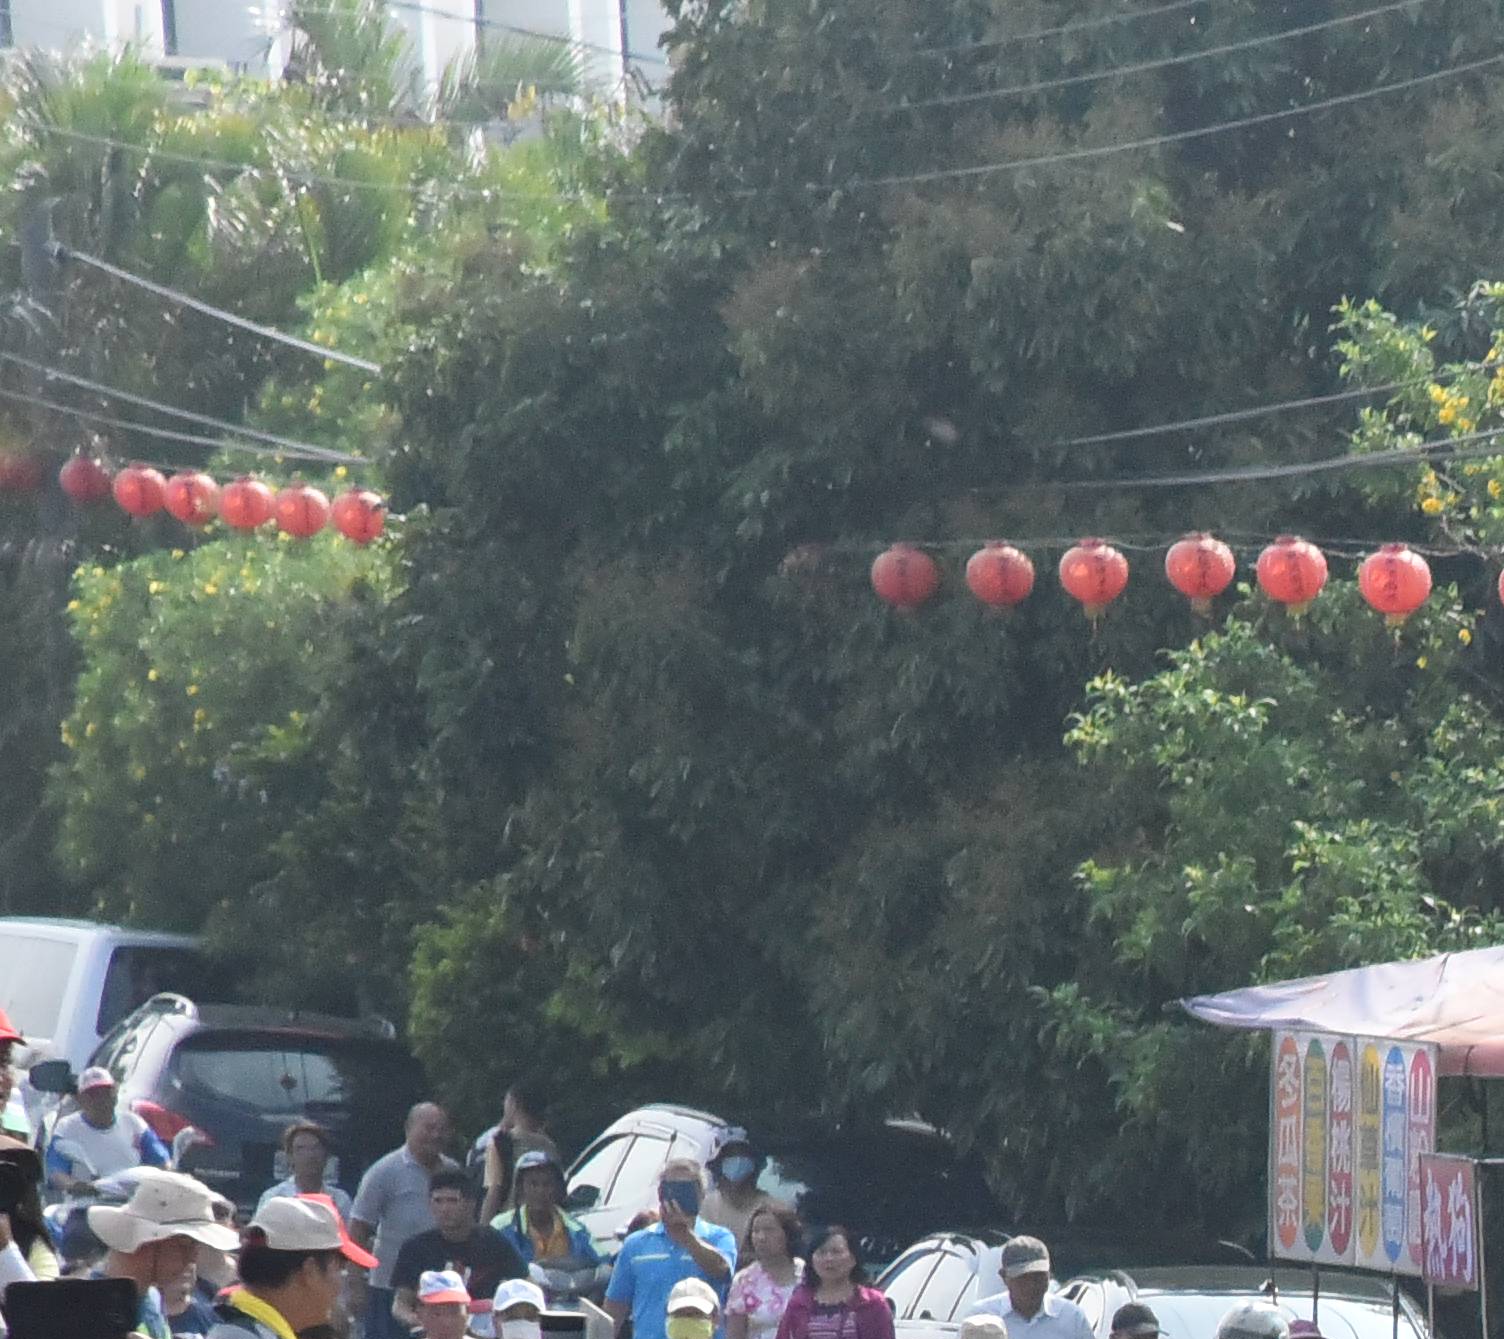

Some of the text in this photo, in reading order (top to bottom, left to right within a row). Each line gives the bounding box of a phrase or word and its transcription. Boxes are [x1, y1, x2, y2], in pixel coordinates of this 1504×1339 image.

[1277, 1055, 1299, 1226] 冬瓜茶
[1330, 1059, 1352, 1234] 楊桃汁
[1424, 1168, 1473, 1283] 熱狗
